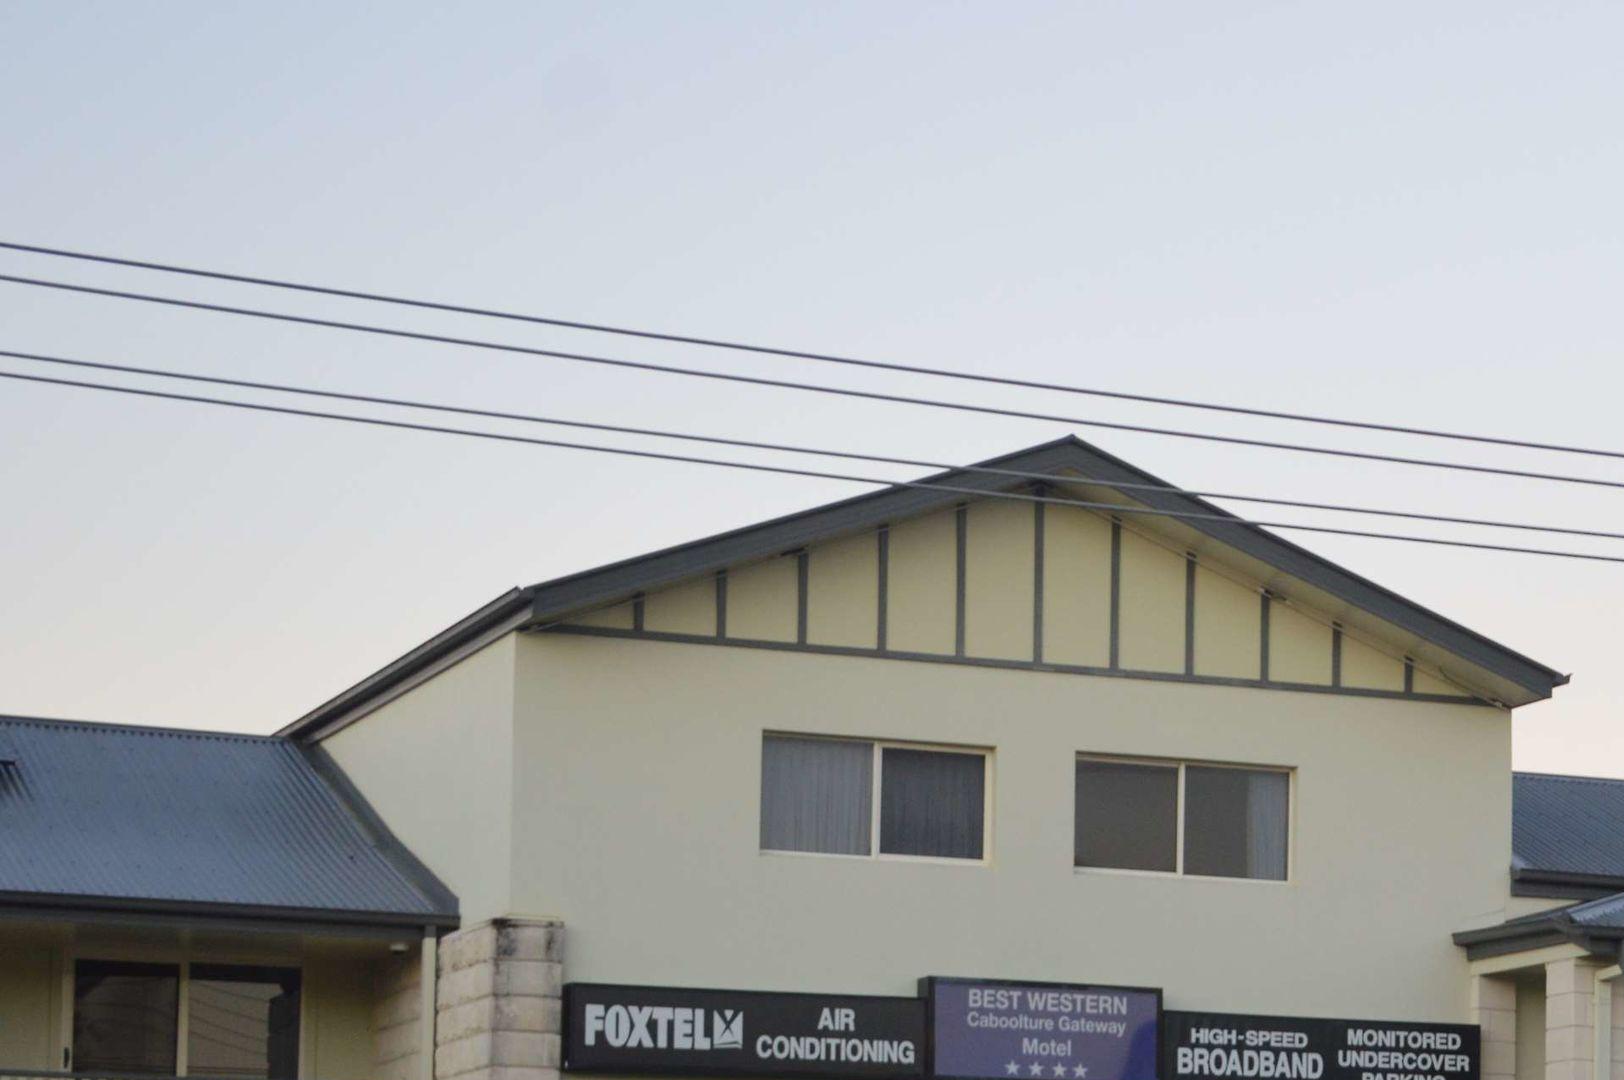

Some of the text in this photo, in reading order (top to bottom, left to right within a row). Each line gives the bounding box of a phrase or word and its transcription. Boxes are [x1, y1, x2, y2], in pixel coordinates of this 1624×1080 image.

[968, 988, 1128, 1015] BEST WESTERN
[585, 1004, 711, 1050] FOXTEL
[817, 1007, 855, 1032] AIR
[967, 1011, 1127, 1037] Caboolture Gateway
[756, 1035, 915, 1064] CONDITIONING
[1022, 1037, 1072, 1057] Motel
[1190, 1028, 1308, 1049] HIGH-SPEED
[1347, 1029, 1462, 1051] MONITORED
[1177, 1047, 1324, 1080] BROADBAND
[1338, 1049, 1470, 1072] UNDERCOVER
